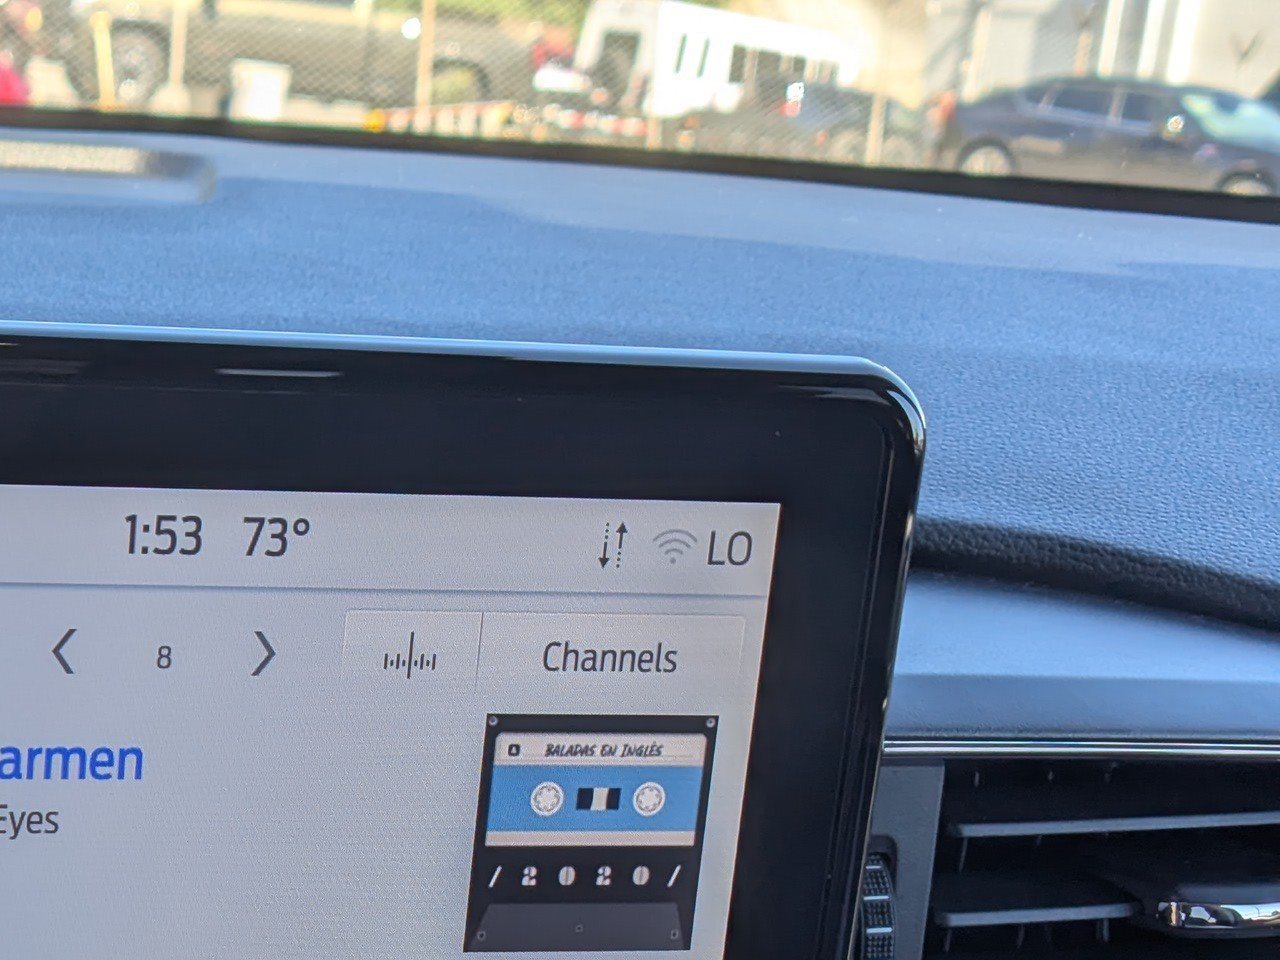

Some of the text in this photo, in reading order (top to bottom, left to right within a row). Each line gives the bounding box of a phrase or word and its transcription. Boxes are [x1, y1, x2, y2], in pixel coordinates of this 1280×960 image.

[125, 514, 310, 557] 1:53 73°
[707, 531, 752, 566] LO
[157, 646, 172, 669] 8
[542, 641, 678, 673] Channels
[545, 744, 595, 757] BALADAS
[600, 745, 617, 757] EN
